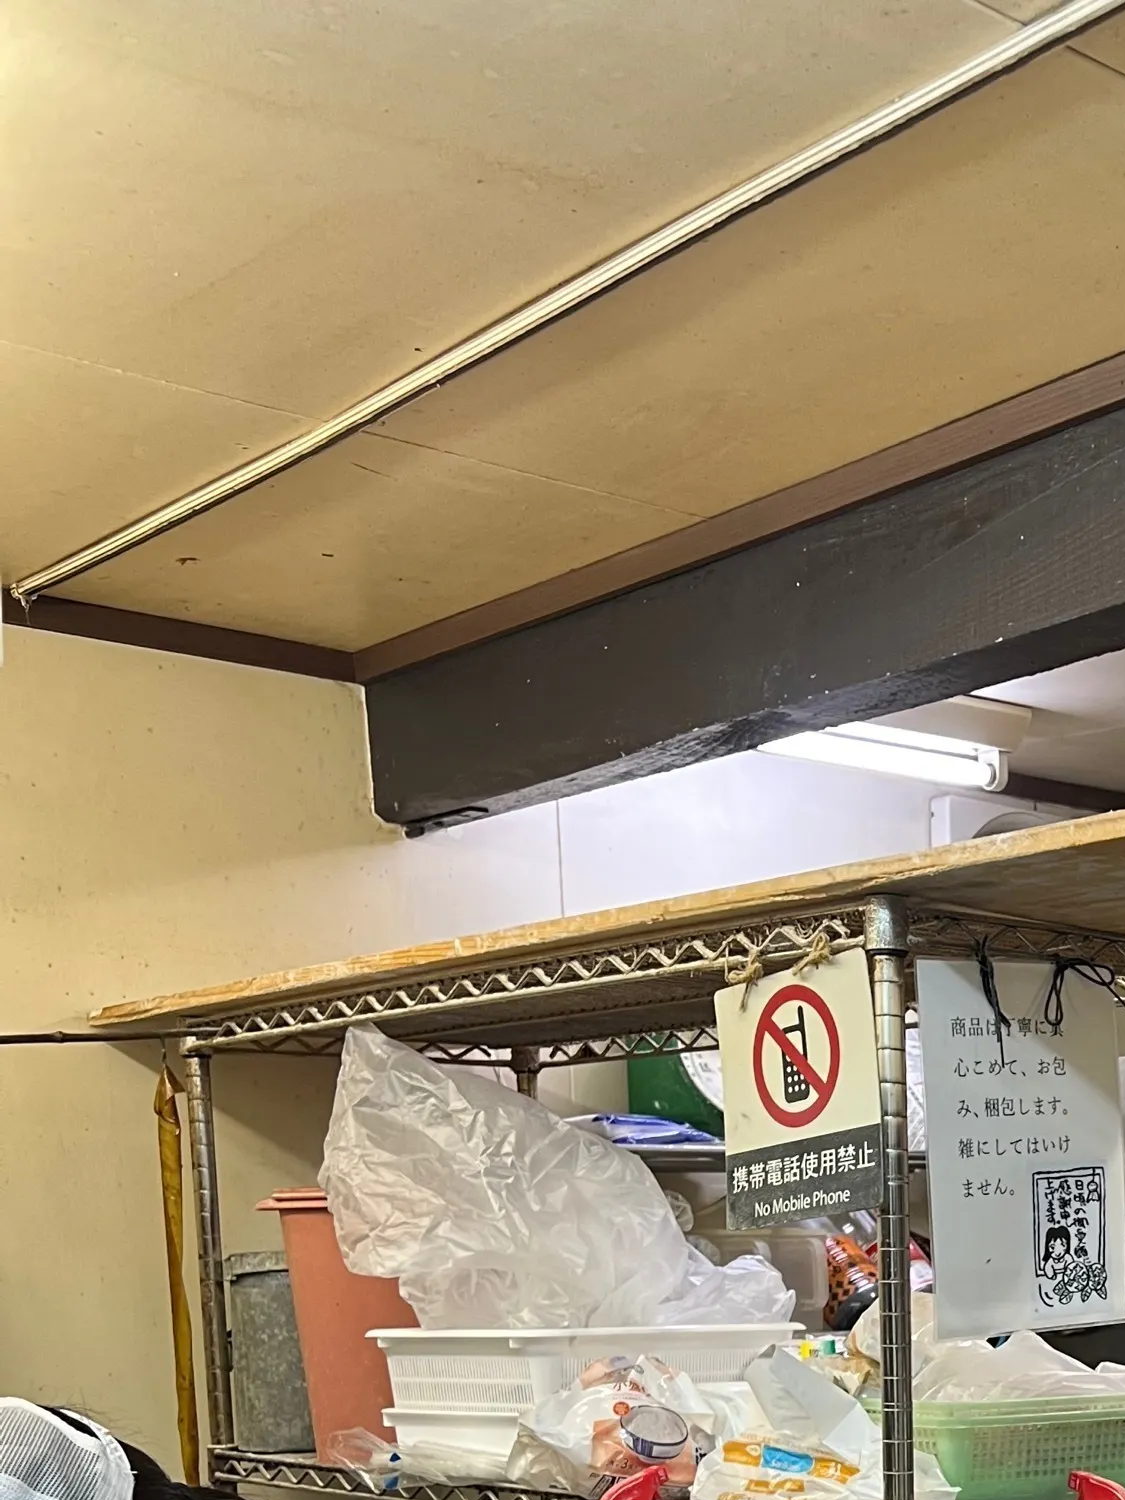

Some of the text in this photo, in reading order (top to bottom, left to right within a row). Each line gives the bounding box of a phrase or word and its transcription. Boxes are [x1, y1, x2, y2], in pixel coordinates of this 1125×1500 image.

[957, 1096, 1068, 1118] み、梱包します。
[958, 1135, 1071, 1159] 雑にしてはいけ
[732, 1141, 875, 1194] 携帯電話使用禁止
[962, 1178, 1015, 1198] ません。
[754, 1188, 851, 1218] No Mobile Phone
